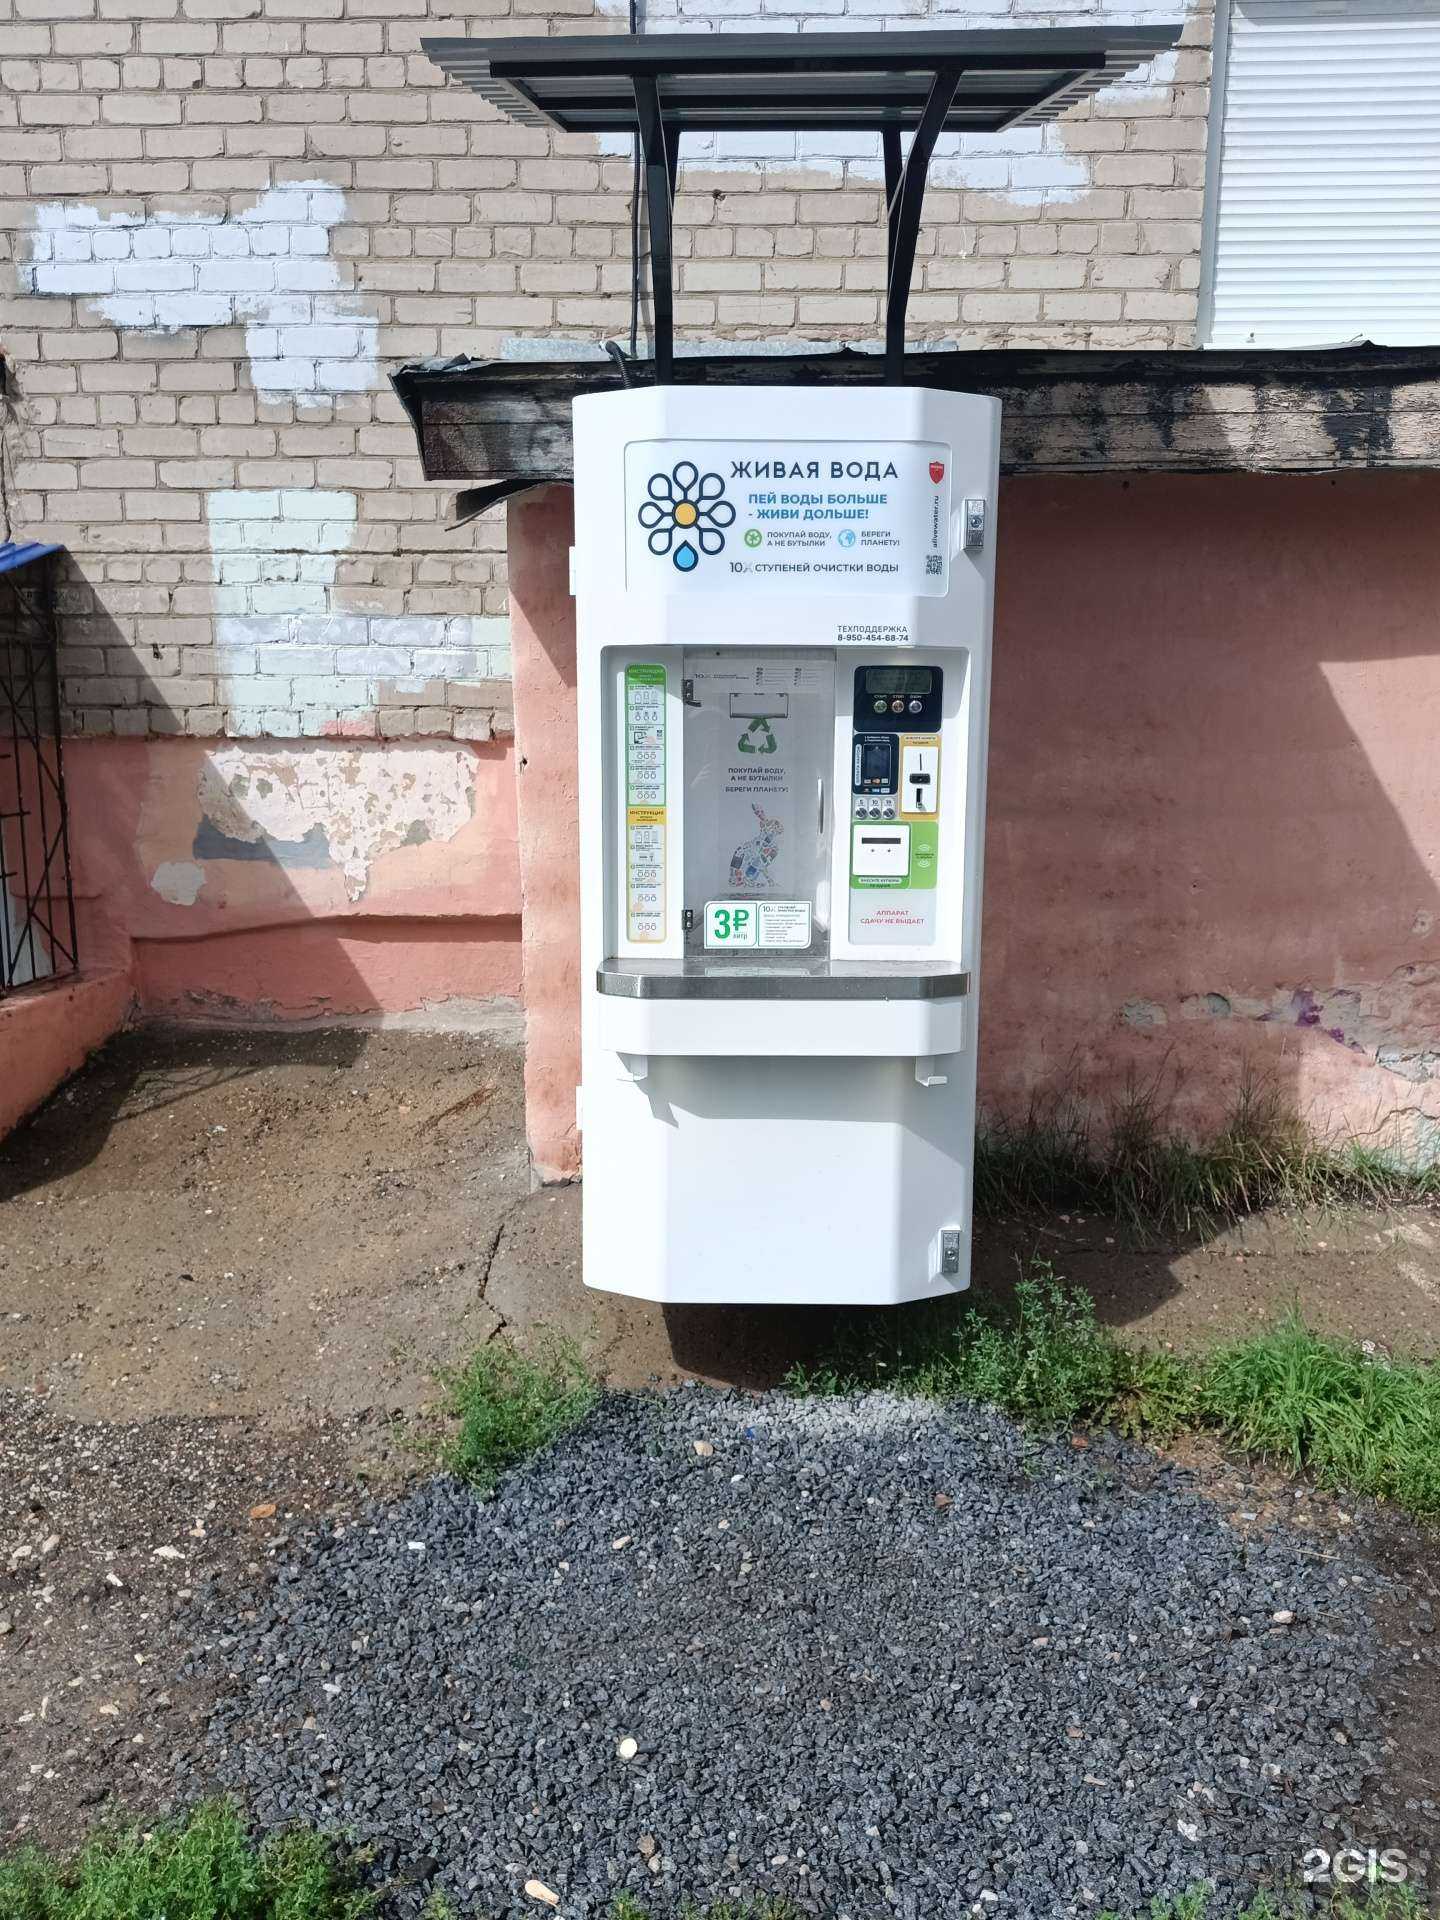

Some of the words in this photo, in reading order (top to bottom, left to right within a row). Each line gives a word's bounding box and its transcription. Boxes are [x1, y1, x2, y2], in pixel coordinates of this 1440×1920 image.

[730, 461, 819, 479] ЖИВАЯ
[830, 461, 899, 481] ВОДА
[749, 491, 777, 504] ПЕЙ
[781, 494, 823, 506] ВОДЫ
[827, 494, 888, 504] БОЛЬШЕ
[757, 509, 799, 519] ЖИВИ
[803, 509, 869, 521] ДОЛЬШЕ!
[767, 530, 806, 538] ПОКУПАЙ
[808, 531, 832, 540] ВОДУ,
[755, 561, 810, 572] СТУПЕНЕЙ
[813, 564, 864, 572] ОЧИСТКИ
[866, 564, 899, 573] ВОДЫ
[837, 625, 908, 634] ТЕХПОДДЕРЖКА
[837, 634, 909, 642] 8-950-454-68-74
